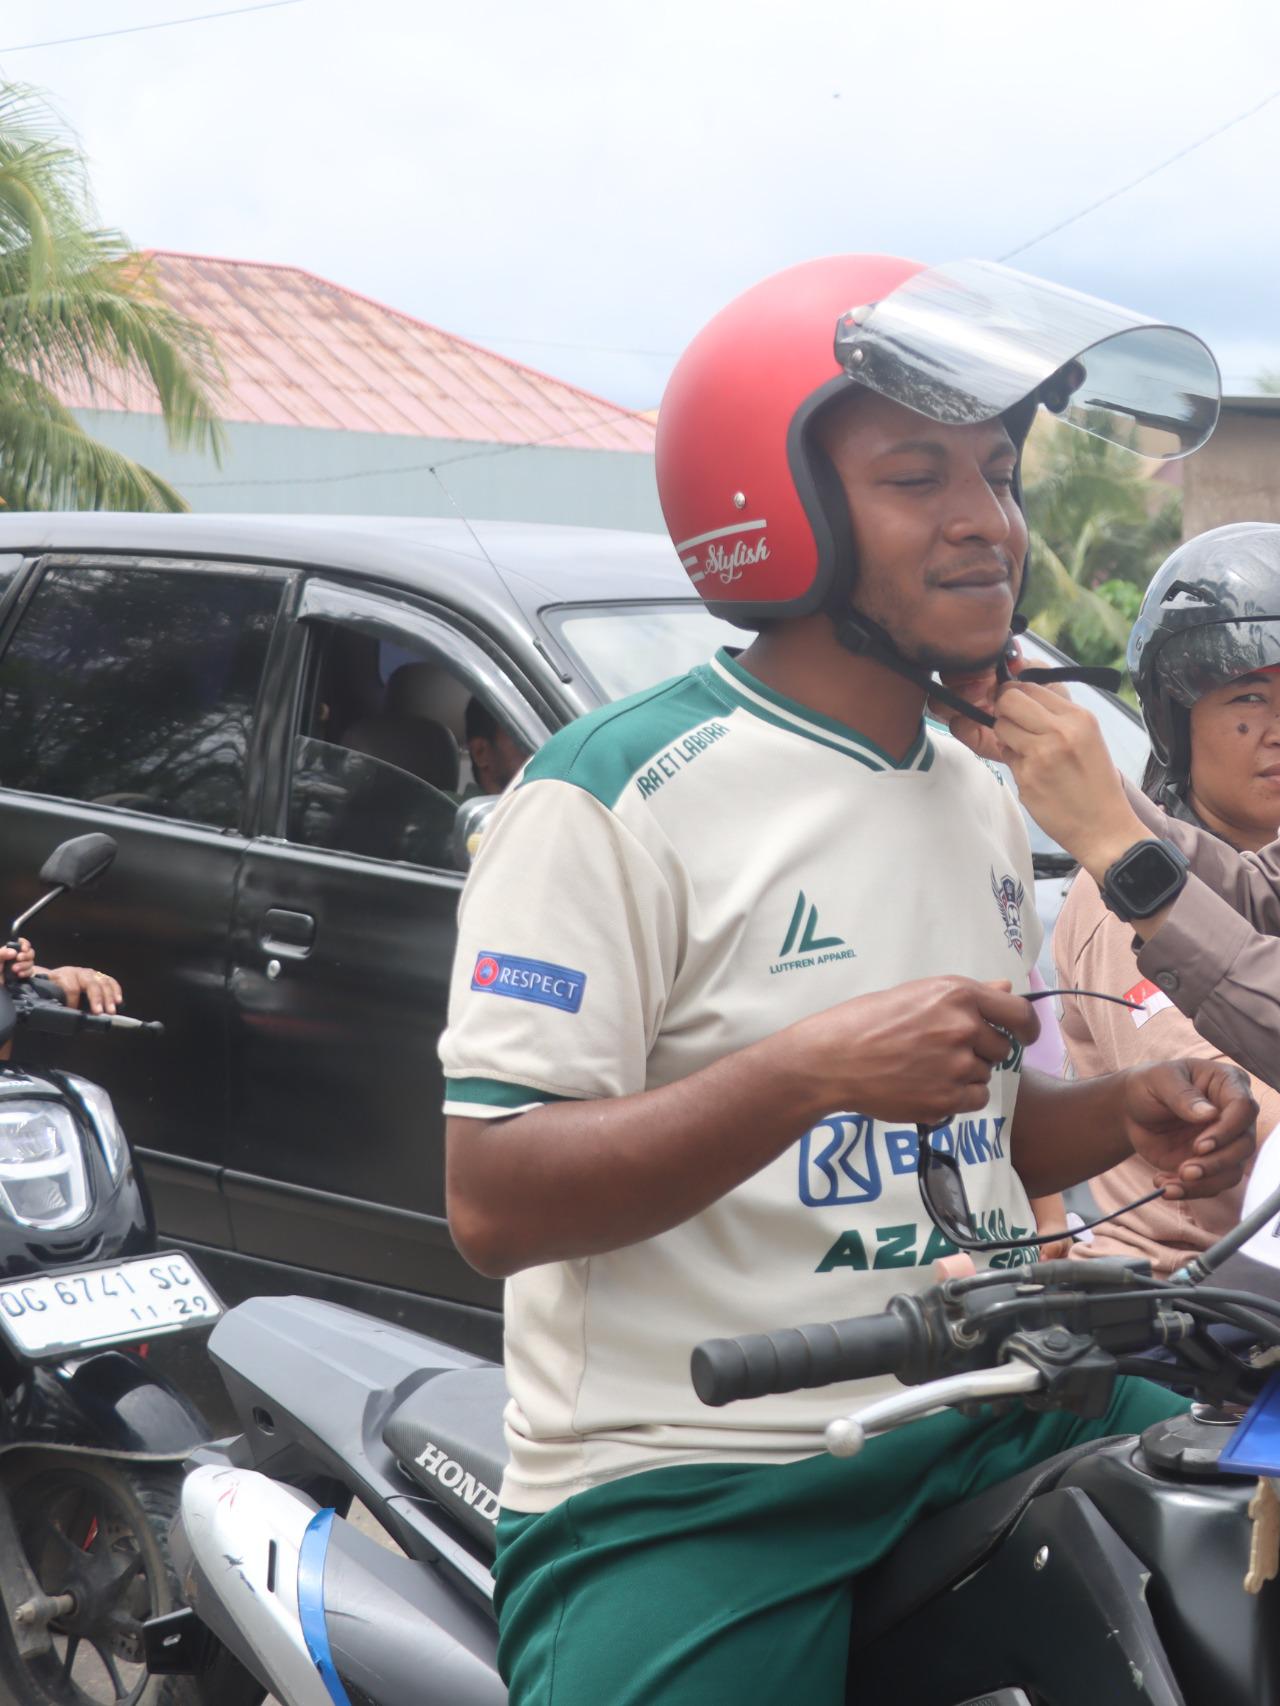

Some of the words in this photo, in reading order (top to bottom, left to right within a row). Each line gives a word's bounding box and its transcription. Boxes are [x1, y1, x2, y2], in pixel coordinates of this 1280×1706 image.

[704, 537, 771, 584] Stylish
[656, 752, 681, 779] ET
[674, 722, 731, 763] LABORA
[769, 957, 816, 975] LUTFREN
[817, 949, 857, 966] APPAREL
[500, 967, 579, 999] RESPECT
[54, 1271, 136, 1305] 6741
[149, 1264, 191, 1291] SC
[173, 1295, 208, 1315] 29
[414, 1441, 500, 1527] HOND
